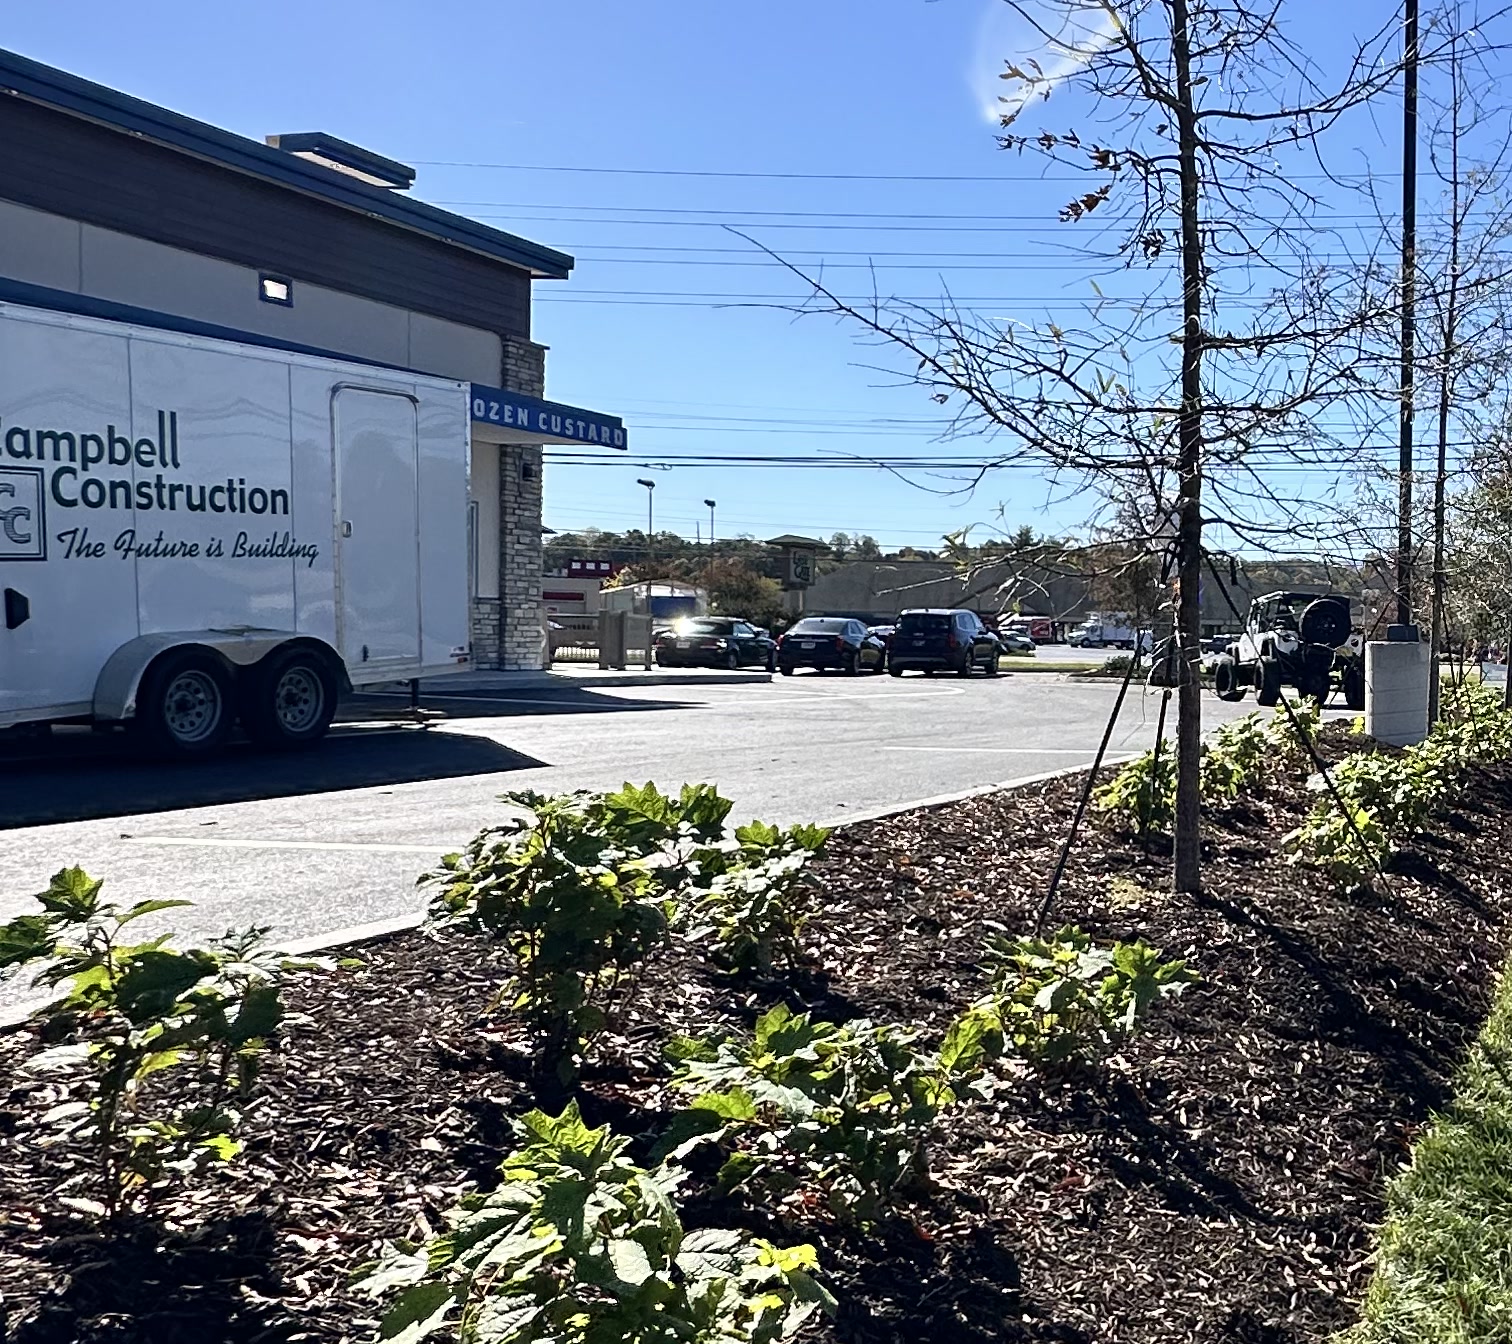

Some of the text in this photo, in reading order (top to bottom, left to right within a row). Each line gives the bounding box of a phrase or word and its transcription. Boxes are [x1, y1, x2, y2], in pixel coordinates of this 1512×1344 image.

[0, 410, 181, 472] ampbell
[473, 398, 624, 446] OZEN CUSTARD
[51, 465, 289, 515] Construction
[57, 527, 319, 568] The Future is Building
